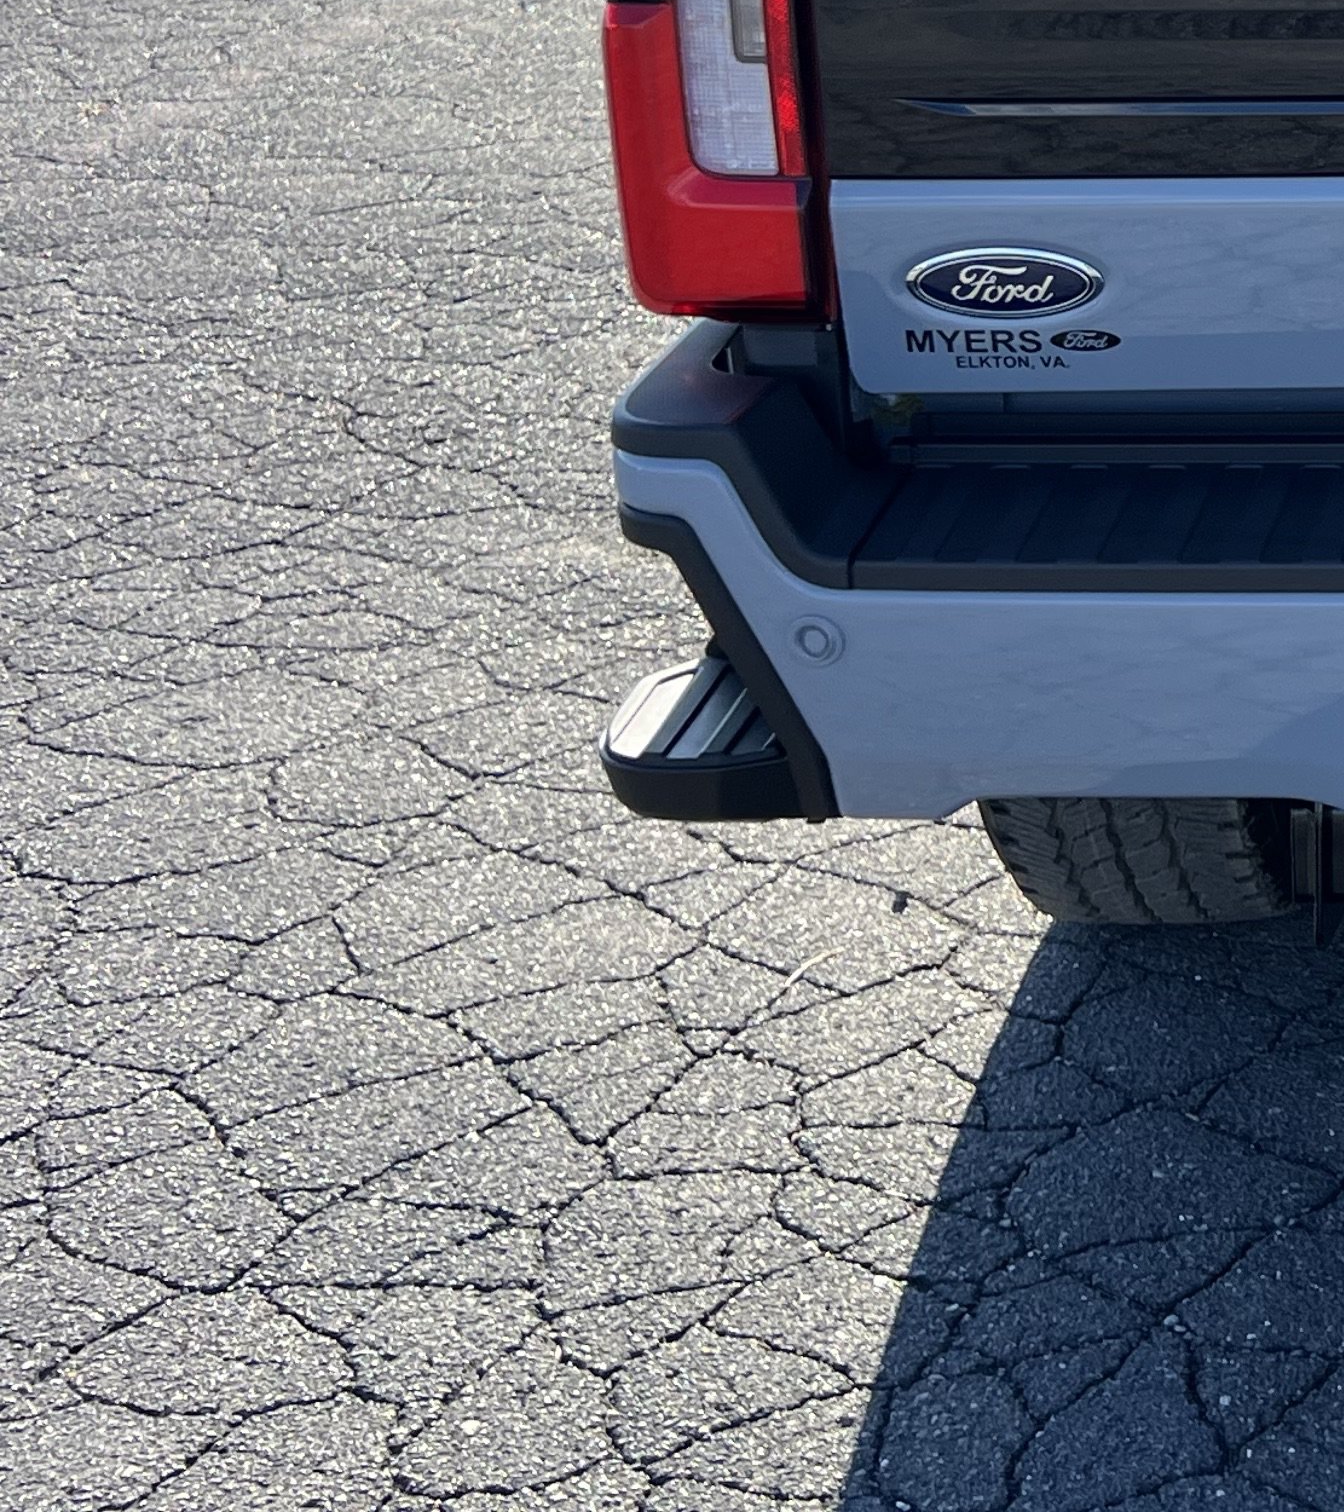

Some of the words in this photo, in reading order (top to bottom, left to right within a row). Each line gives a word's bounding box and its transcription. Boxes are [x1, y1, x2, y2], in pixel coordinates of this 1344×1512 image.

[951, 264, 1054, 304] Ford
[905, 329, 1043, 354] MYERS
[1062, 331, 1109, 349] Ford
[956, 355, 1036, 370] ELKTON,
